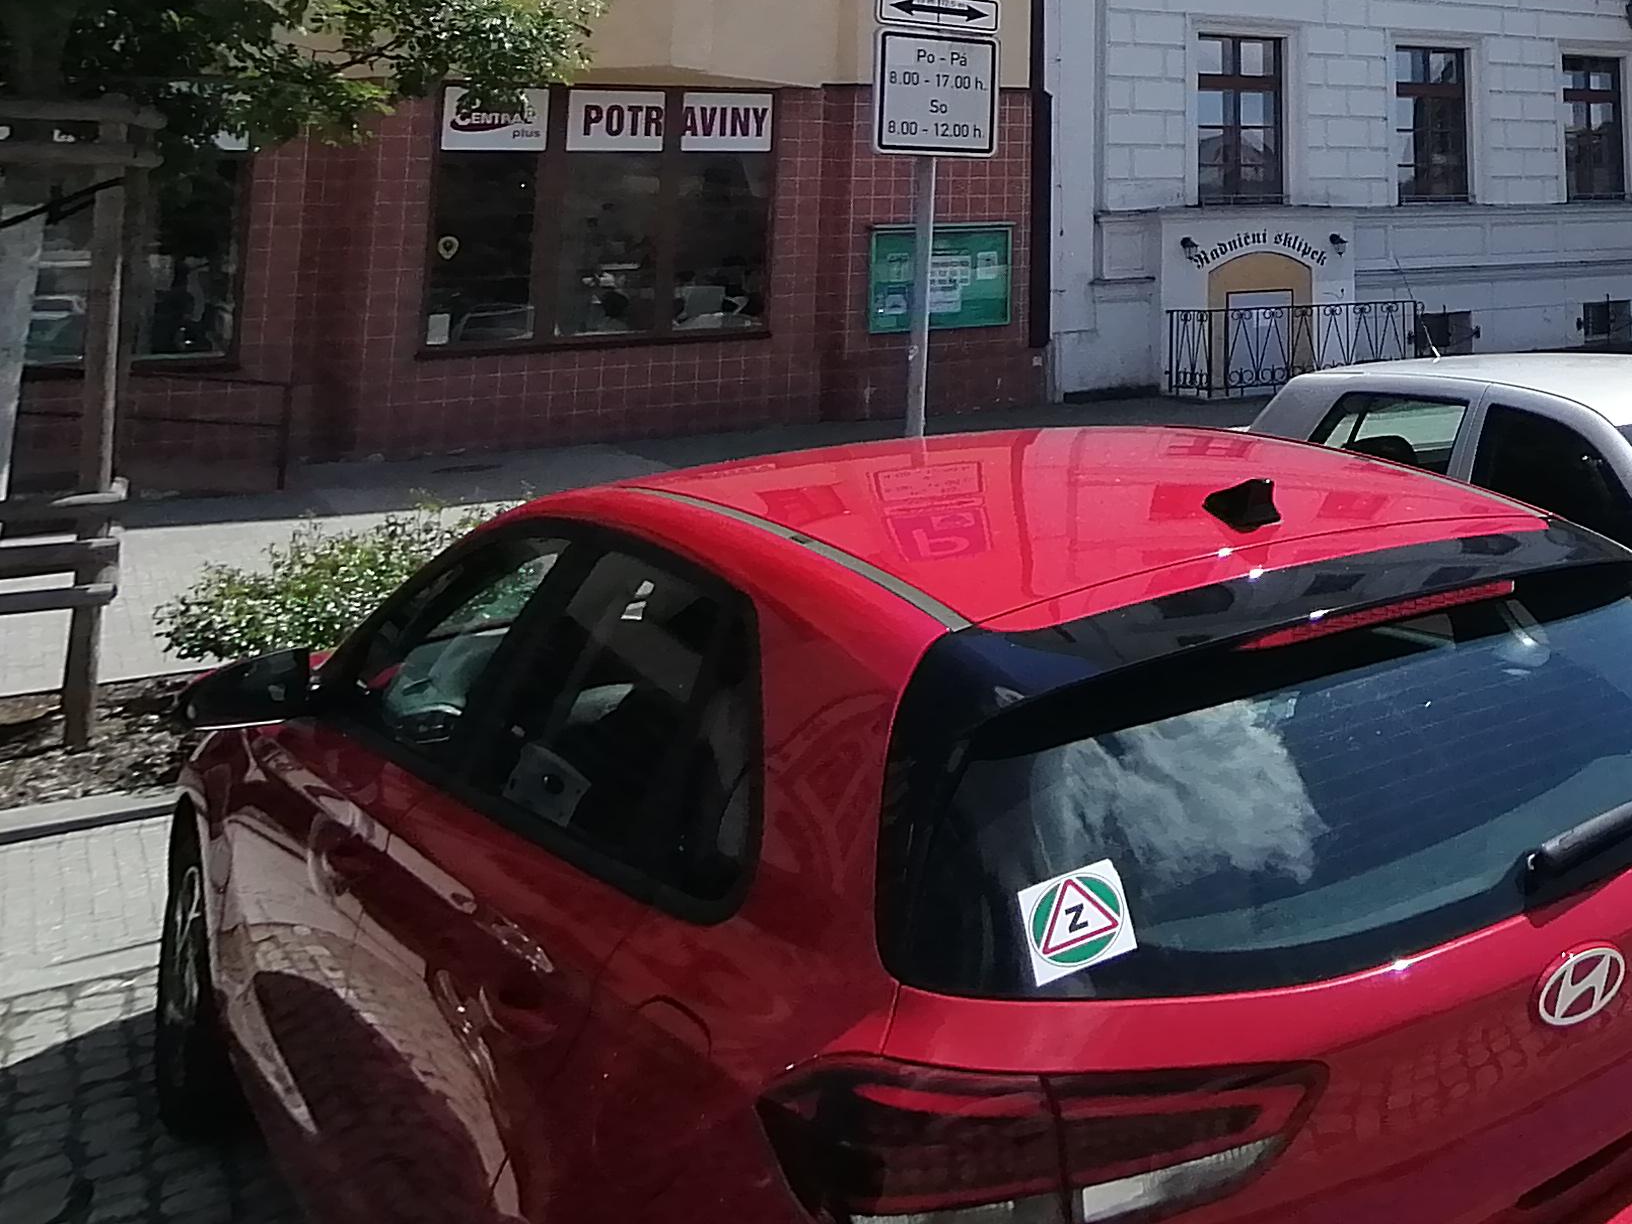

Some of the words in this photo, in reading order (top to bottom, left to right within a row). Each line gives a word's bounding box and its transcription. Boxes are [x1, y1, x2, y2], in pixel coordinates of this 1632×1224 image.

[917, 49, 935, 64] Po
[950, 52, 967, 66] Pá
[889, 71, 919, 86] 8.00
[936, 74, 971, 89] 17.00
[929, 99, 948, 114] So
[512, 128, 541, 139] plus
[888, 120, 918, 136] 8.00
[934, 123, 969, 137] 12.00
[1065, 903, 1089, 933] Z
